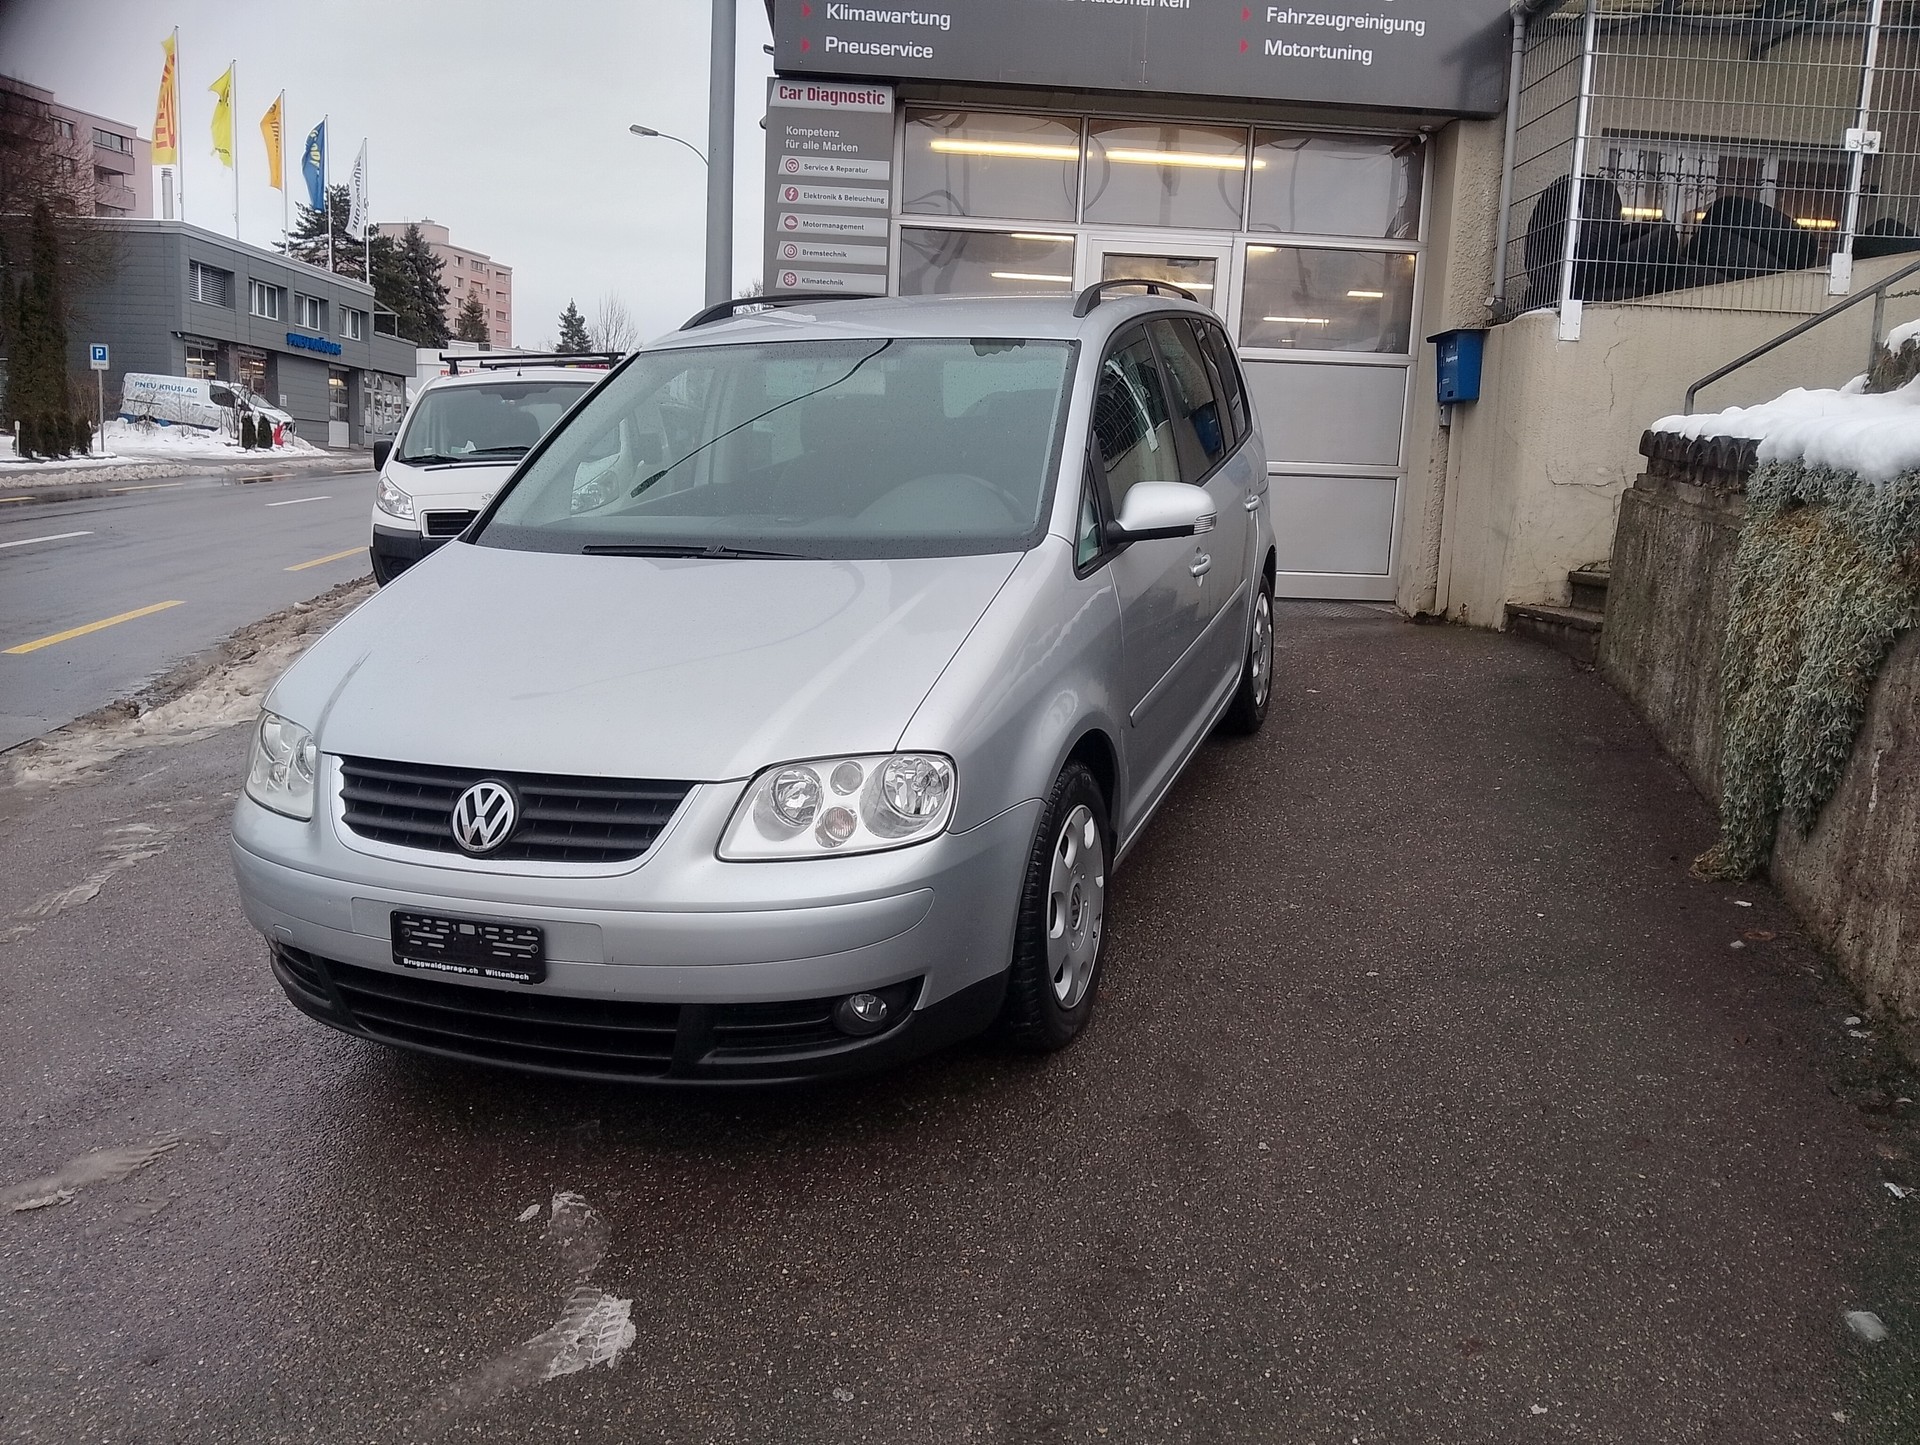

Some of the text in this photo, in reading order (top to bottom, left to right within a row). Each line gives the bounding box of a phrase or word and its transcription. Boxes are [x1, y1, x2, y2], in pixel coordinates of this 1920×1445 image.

[826, 3, 951, 31] Klimawartung
[1266, 6, 1426, 37] Fahrzeugreinigung
[825, 36, 933, 59] Pneuservice
[1264, 39, 1373, 66] Motortuning
[779, 86, 885, 106] Car Diagnostic
[786, 126, 840, 138] Kompetenz
[785, 139, 858, 153] für alle Marken
[804, 163, 828, 172] Service
[836, 165, 869, 174] Reparatur
[803, 192, 837, 201] Elektronik
[844, 194, 885, 204] Beleuchtung
[802, 221, 865, 231] Motormanagement
[802, 249, 847, 258] Bremstechnik
[801, 277, 844, 286] Klimatechnik
[95, 348, 104, 359] P
[134, 381, 157, 389] PNEU
[452, 782, 514, 852] VW
[403, 958, 530, 980] Bruggwaldgarage.ch Wittenbach
